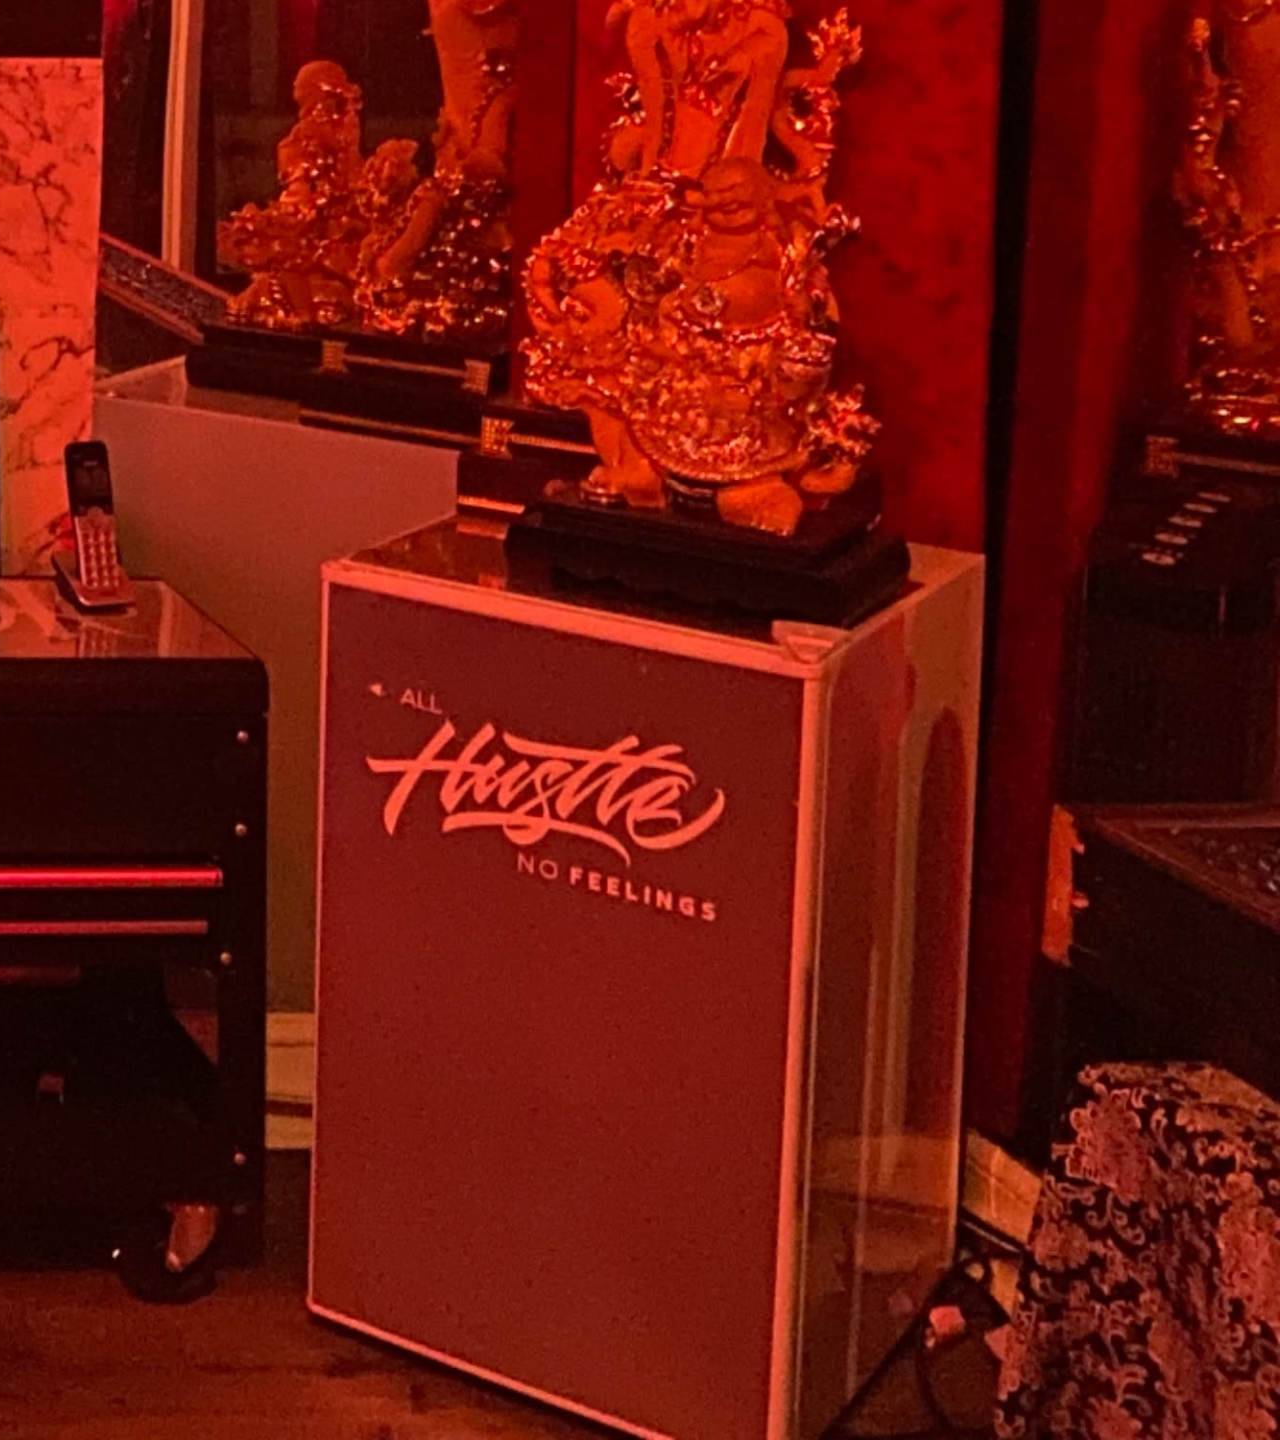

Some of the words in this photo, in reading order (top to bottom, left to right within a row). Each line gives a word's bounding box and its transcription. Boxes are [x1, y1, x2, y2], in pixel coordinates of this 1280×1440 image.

[400, 687, 443, 715] ALL
[366, 719, 726, 868] Hustle
[517, 852, 559, 880] NO
[569, 866, 717, 921] FEELINGS
